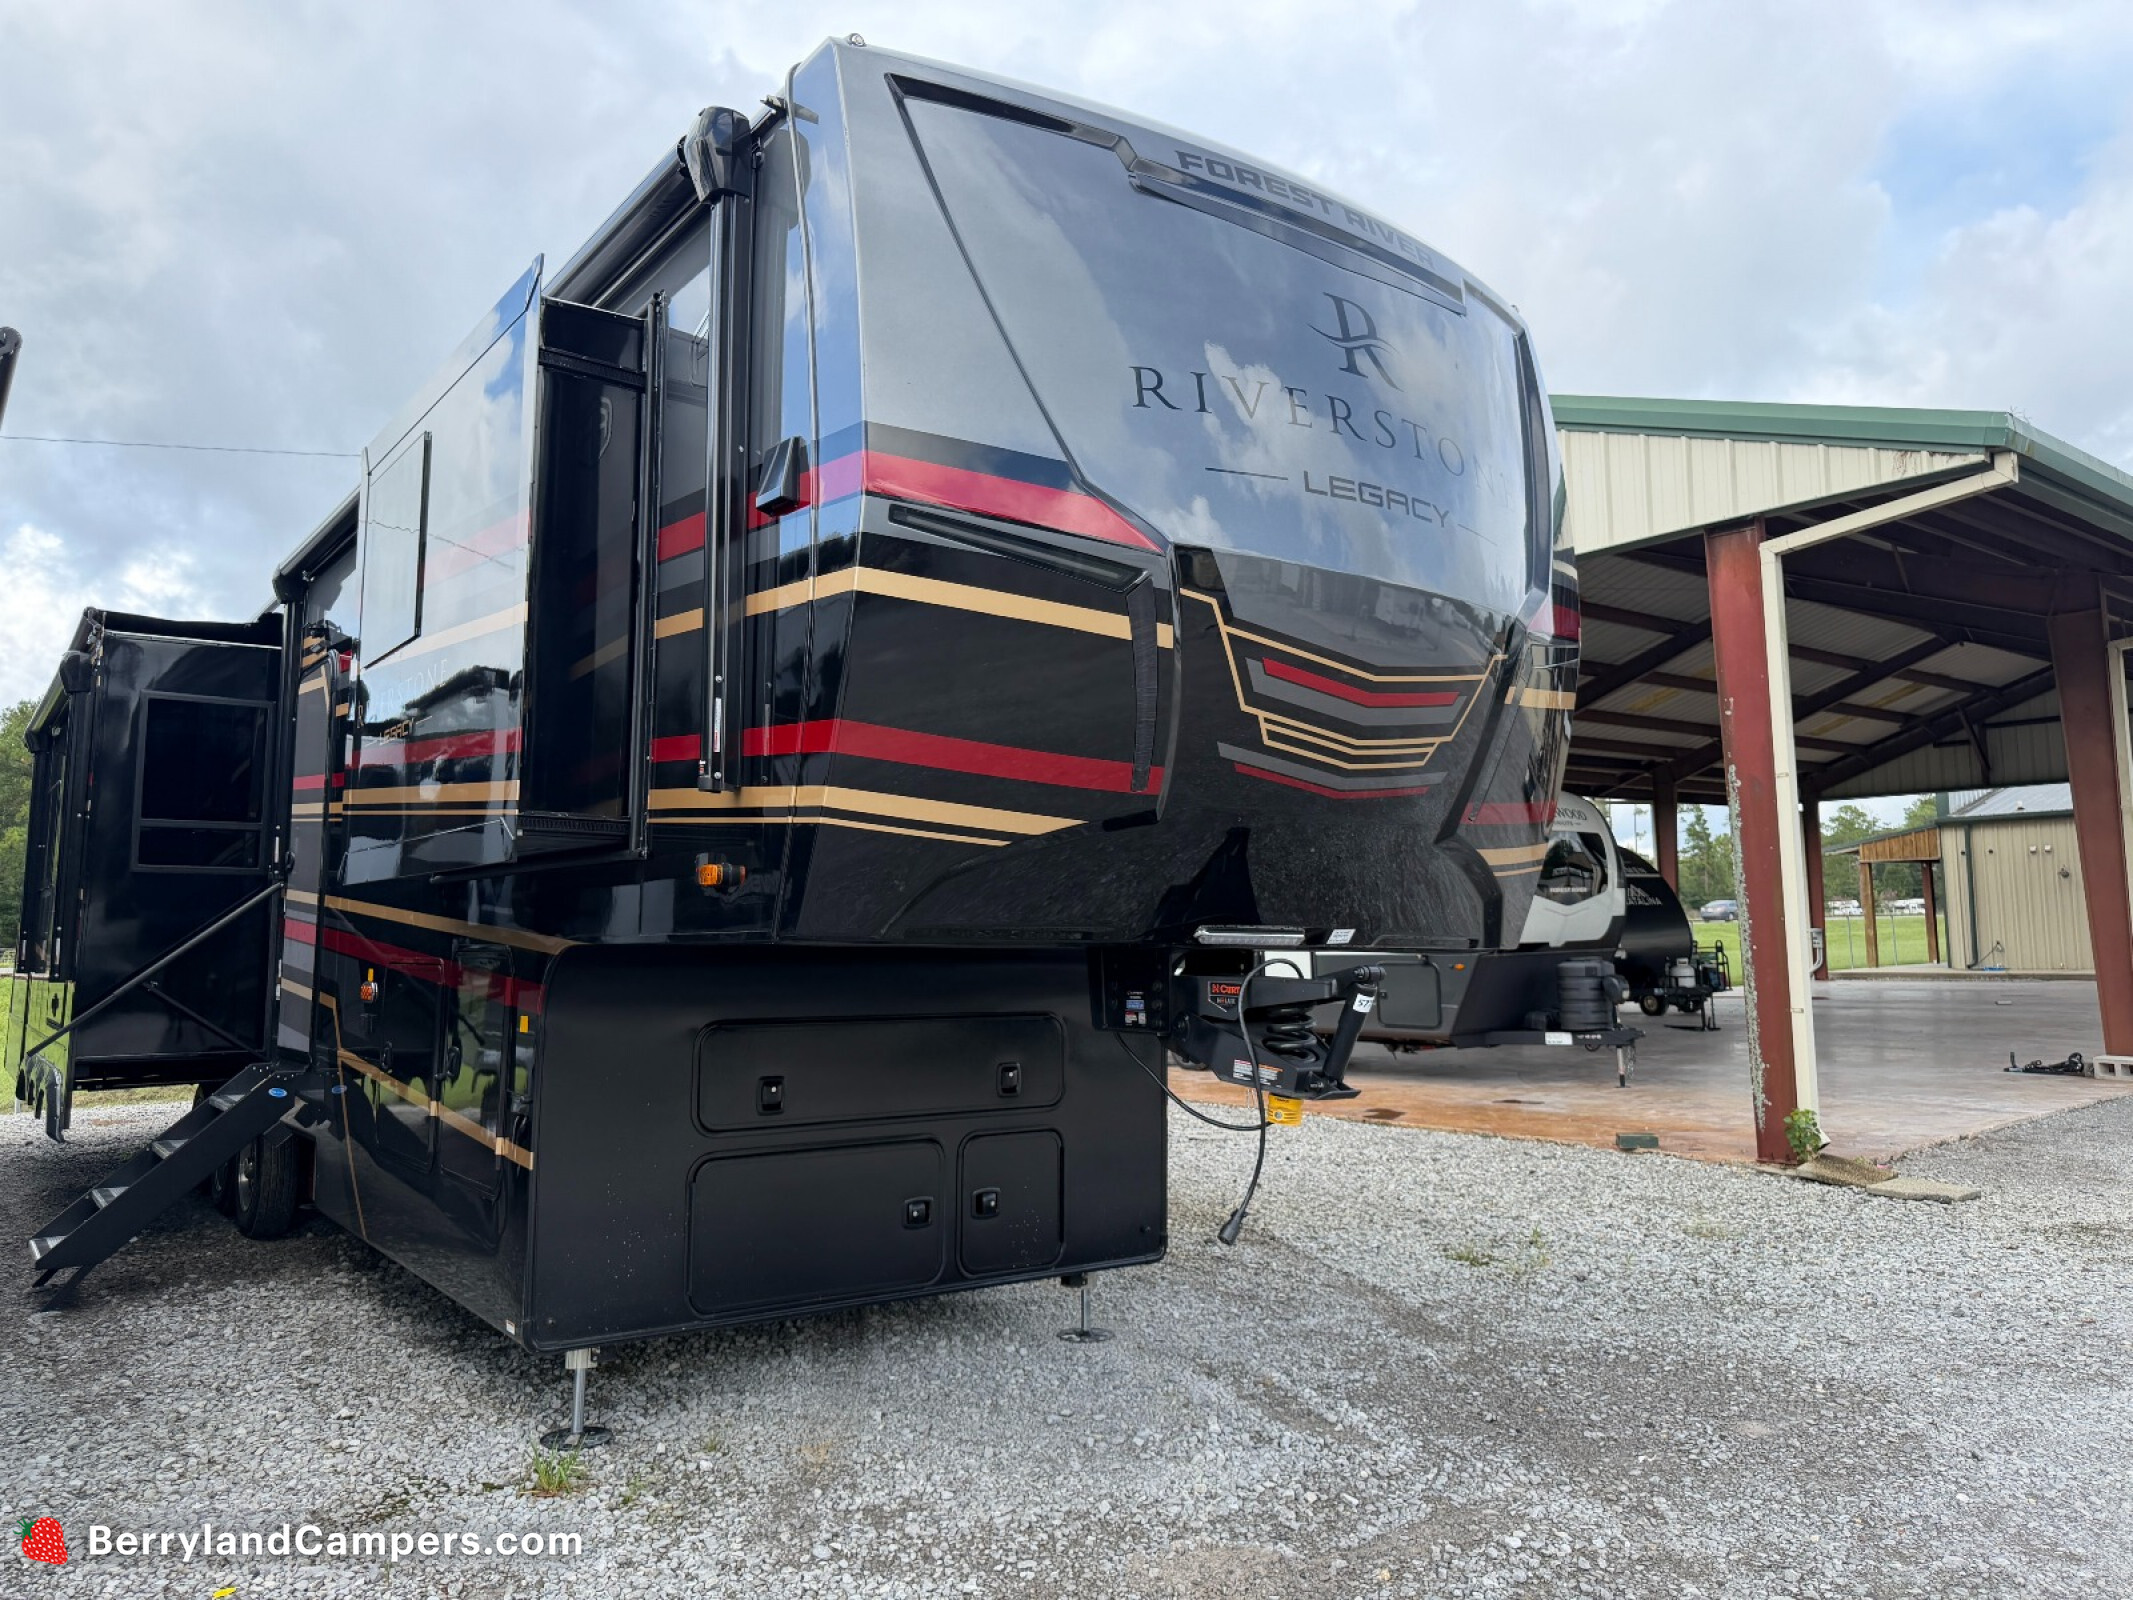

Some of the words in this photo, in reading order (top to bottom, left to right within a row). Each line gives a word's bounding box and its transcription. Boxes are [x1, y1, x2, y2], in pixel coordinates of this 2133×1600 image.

[1174, 149, 1336, 217] FOREST
[1344, 203, 1434, 269] RIVER
[1303, 470, 1450, 528] LEGACY
[1626, 895, 1662, 906] ATALINA
